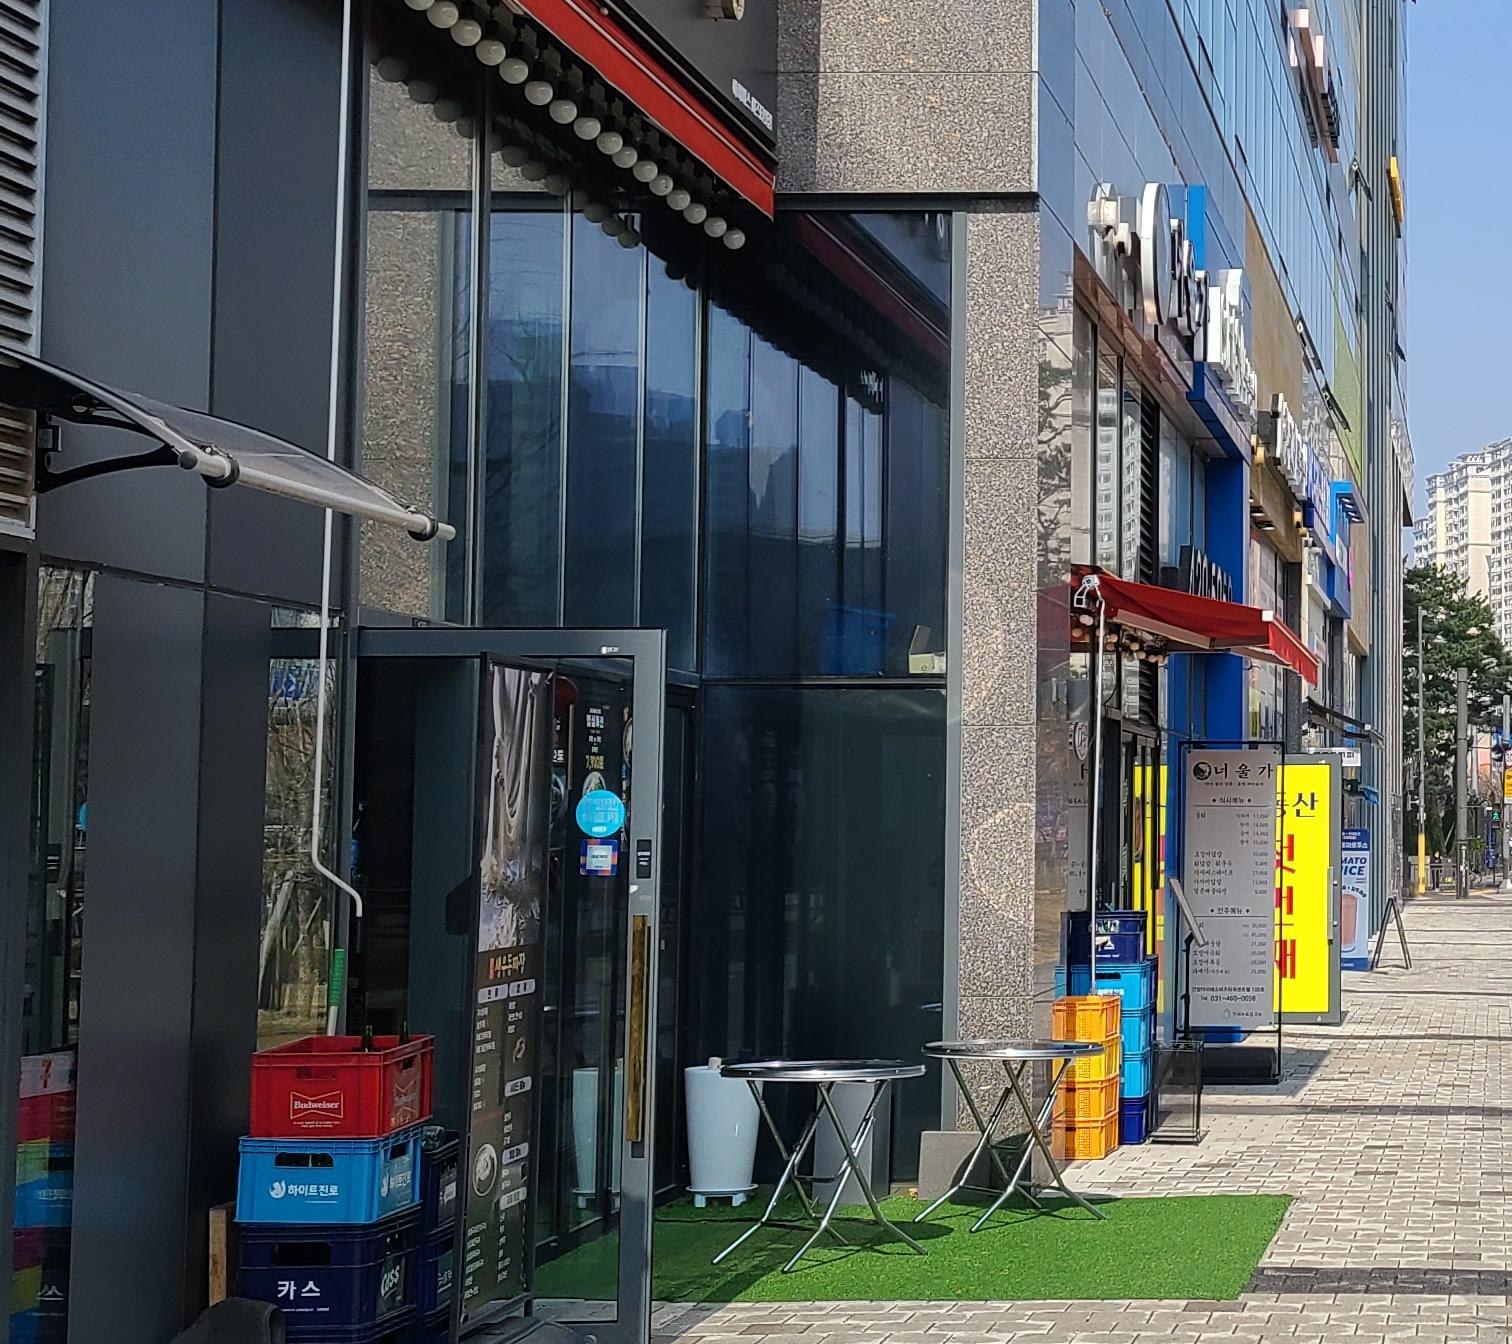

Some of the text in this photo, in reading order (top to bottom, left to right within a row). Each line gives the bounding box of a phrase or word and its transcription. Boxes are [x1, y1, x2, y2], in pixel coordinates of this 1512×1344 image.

[293, 1100, 340, 1110] Budweiser
[287, 1184, 339, 1198] 하이트진로
[277, 1280, 321, 1300] 카스
